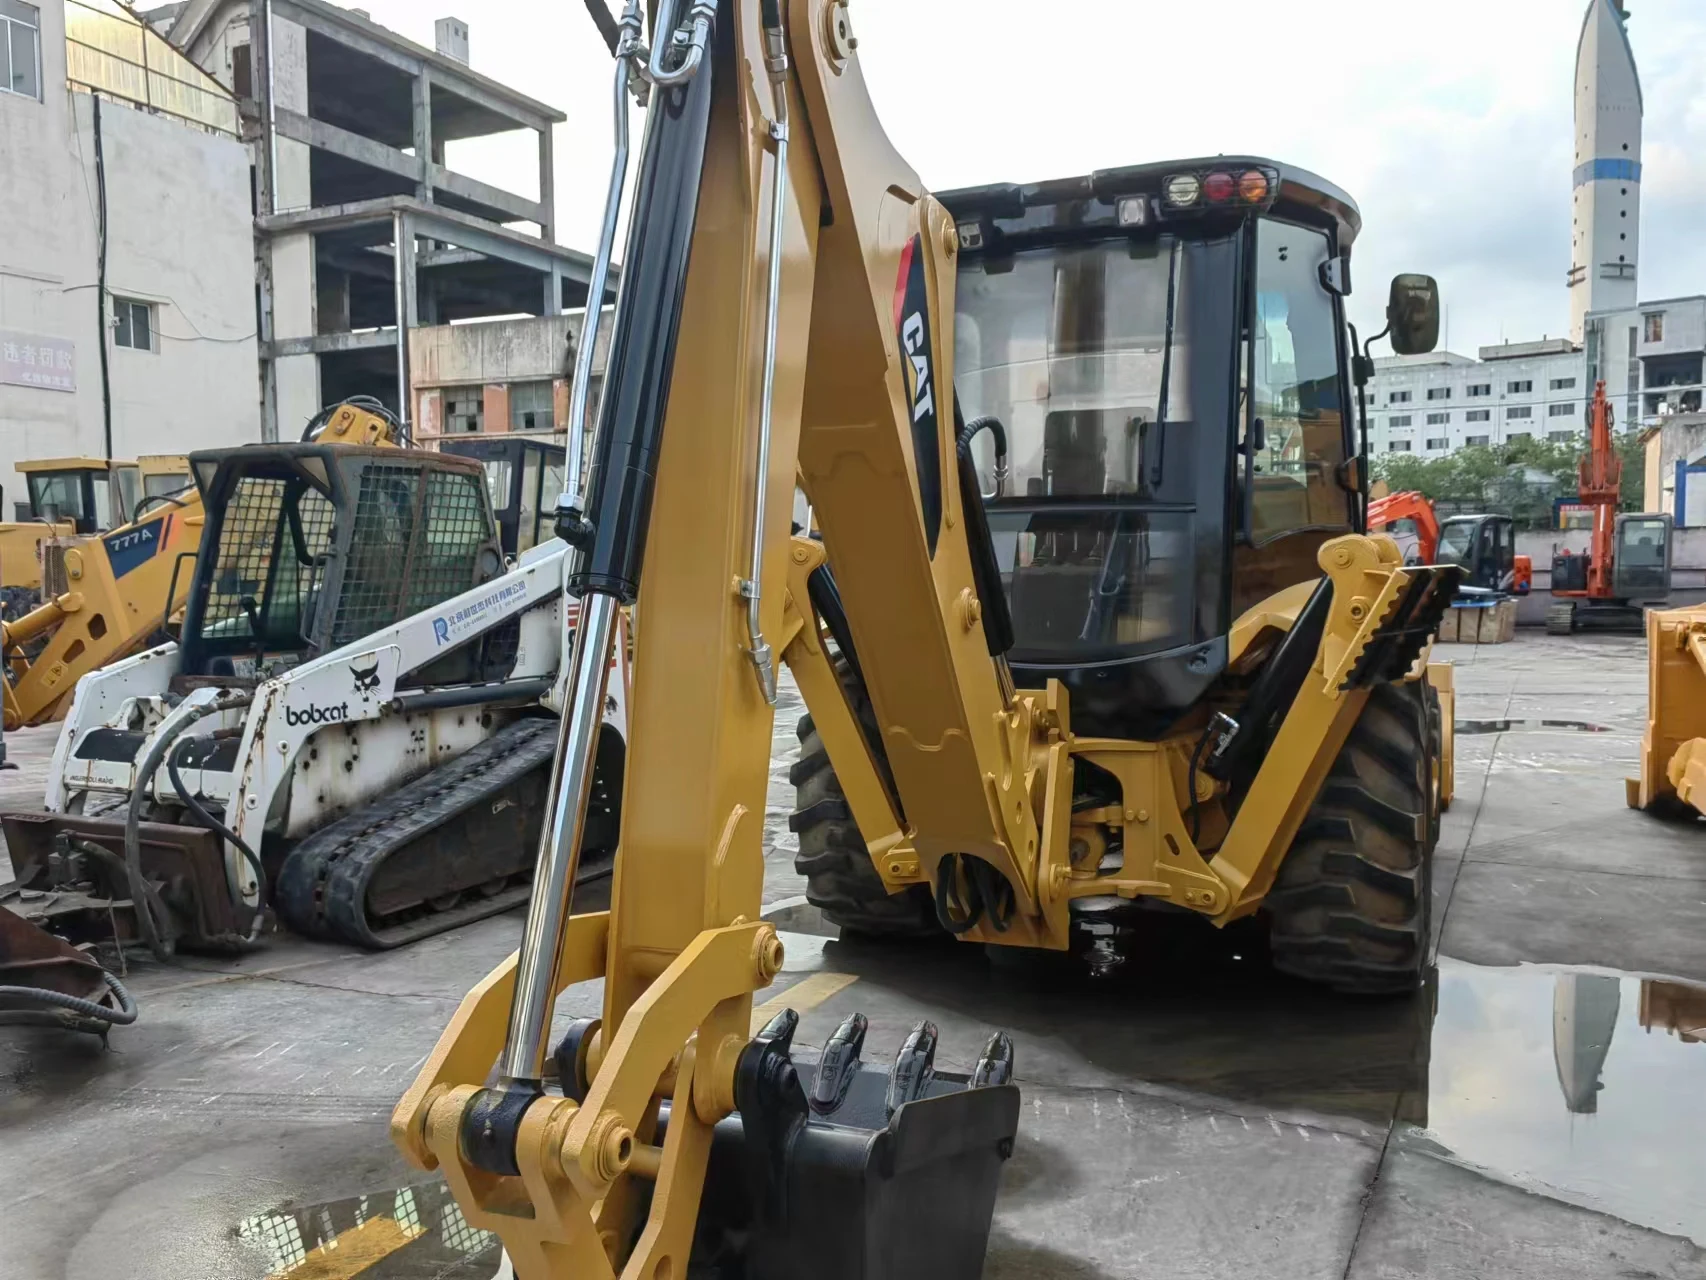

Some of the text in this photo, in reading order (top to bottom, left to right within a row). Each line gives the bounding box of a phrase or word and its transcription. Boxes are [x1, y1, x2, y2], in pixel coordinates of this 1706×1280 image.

[902, 311, 934, 425] CAT
[110, 528, 153, 551] 777A
[286, 701, 348, 726] bobcat
